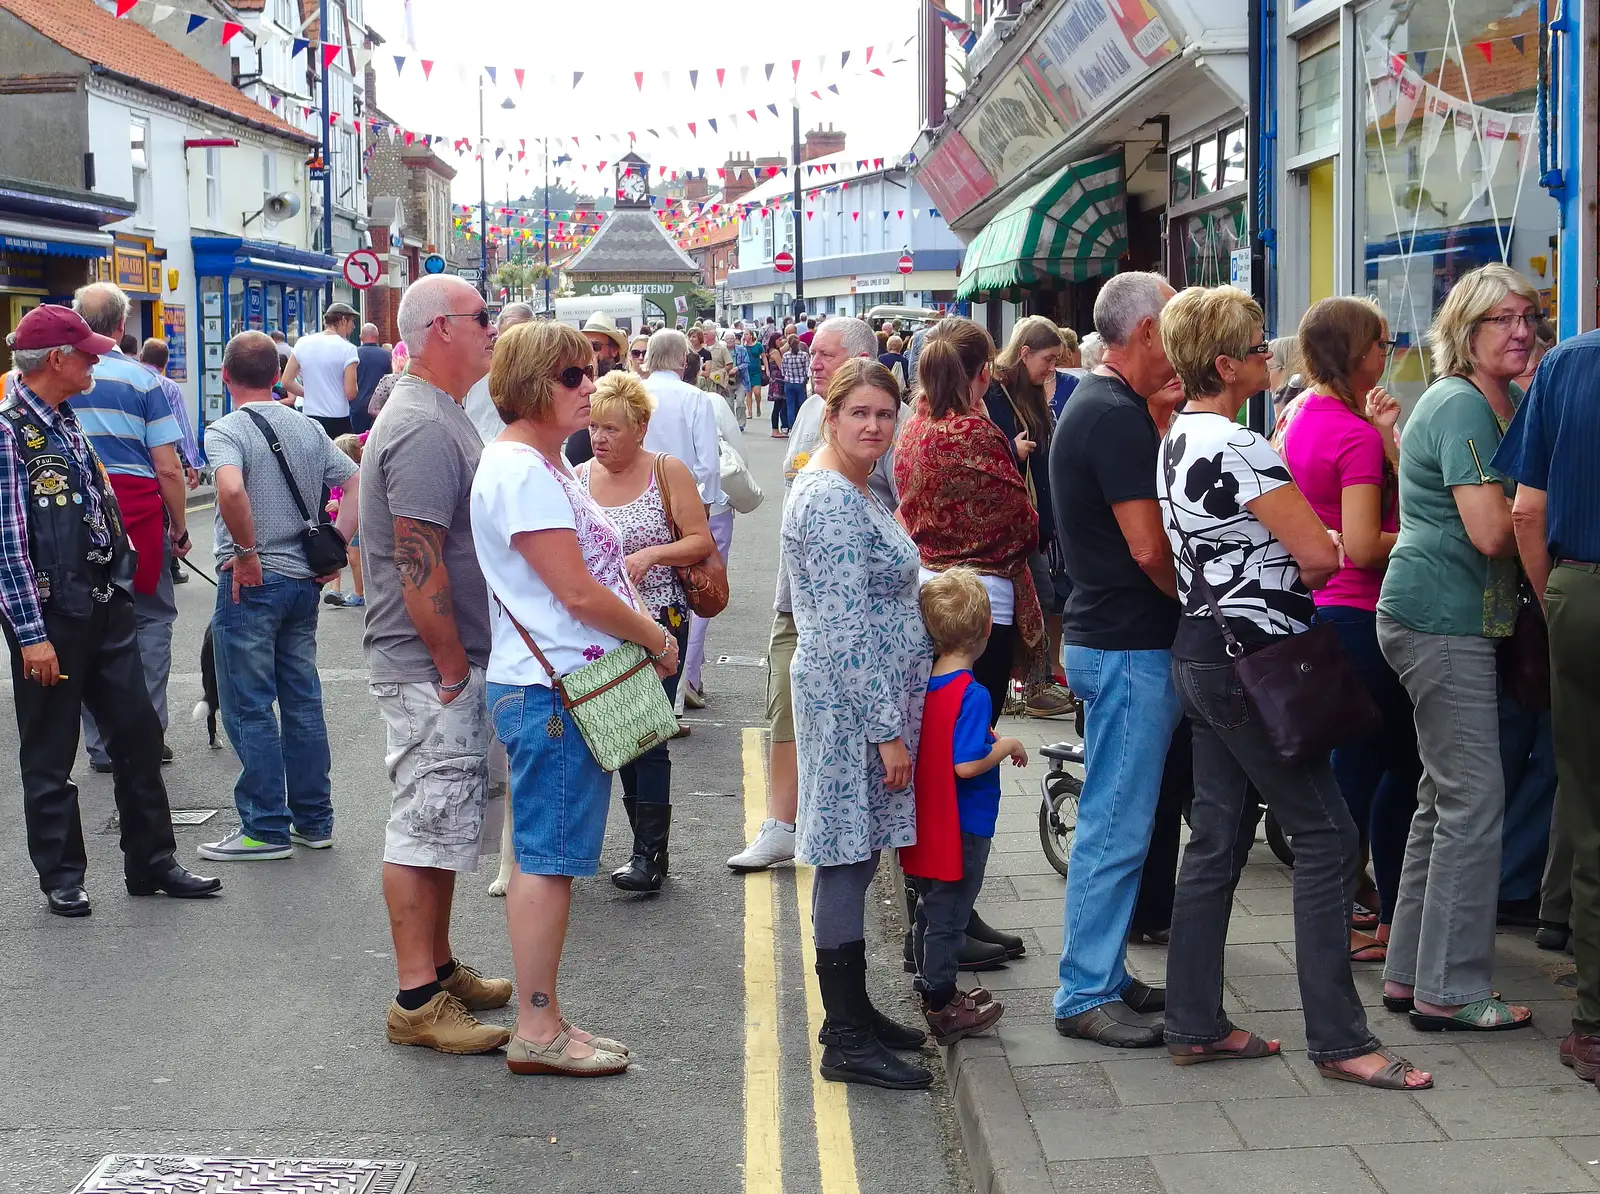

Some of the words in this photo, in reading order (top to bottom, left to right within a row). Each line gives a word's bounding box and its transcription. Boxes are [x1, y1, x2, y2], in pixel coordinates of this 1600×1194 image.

[591, 283, 615, 294] 40's
[617, 284, 675, 294] WEEKEND
[35, 457, 53, 467] Paul
